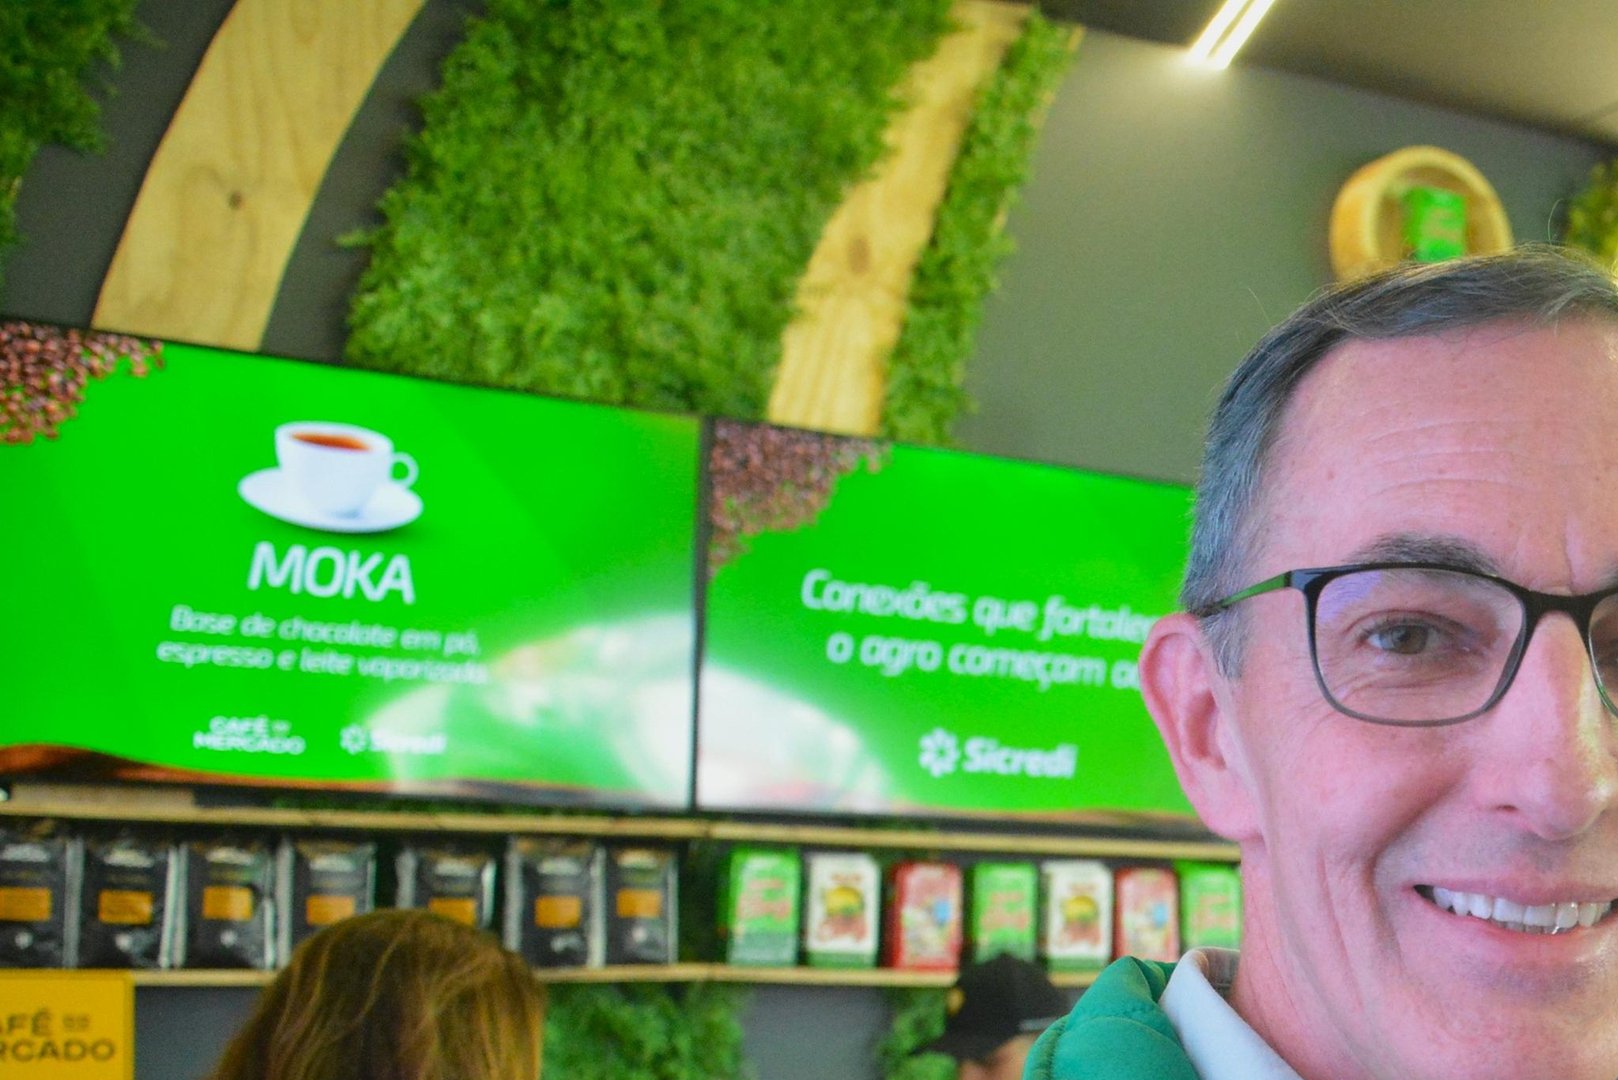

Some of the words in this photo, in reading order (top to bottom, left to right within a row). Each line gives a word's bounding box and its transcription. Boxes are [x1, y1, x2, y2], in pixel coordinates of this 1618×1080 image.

[247, 540, 416, 605] MOKA
[801, 568, 968, 624] Conexões
[973, 596, 1038, 636] que
[156, 640, 274, 670] espresso
[240, 611, 277, 638] de
[278, 616, 398, 649] chocolate
[826, 631, 854, 664] o
[860, 634, 943, 677] agro
[947, 642, 1107, 692] começam
[963, 736, 1078, 779] Sicredi
